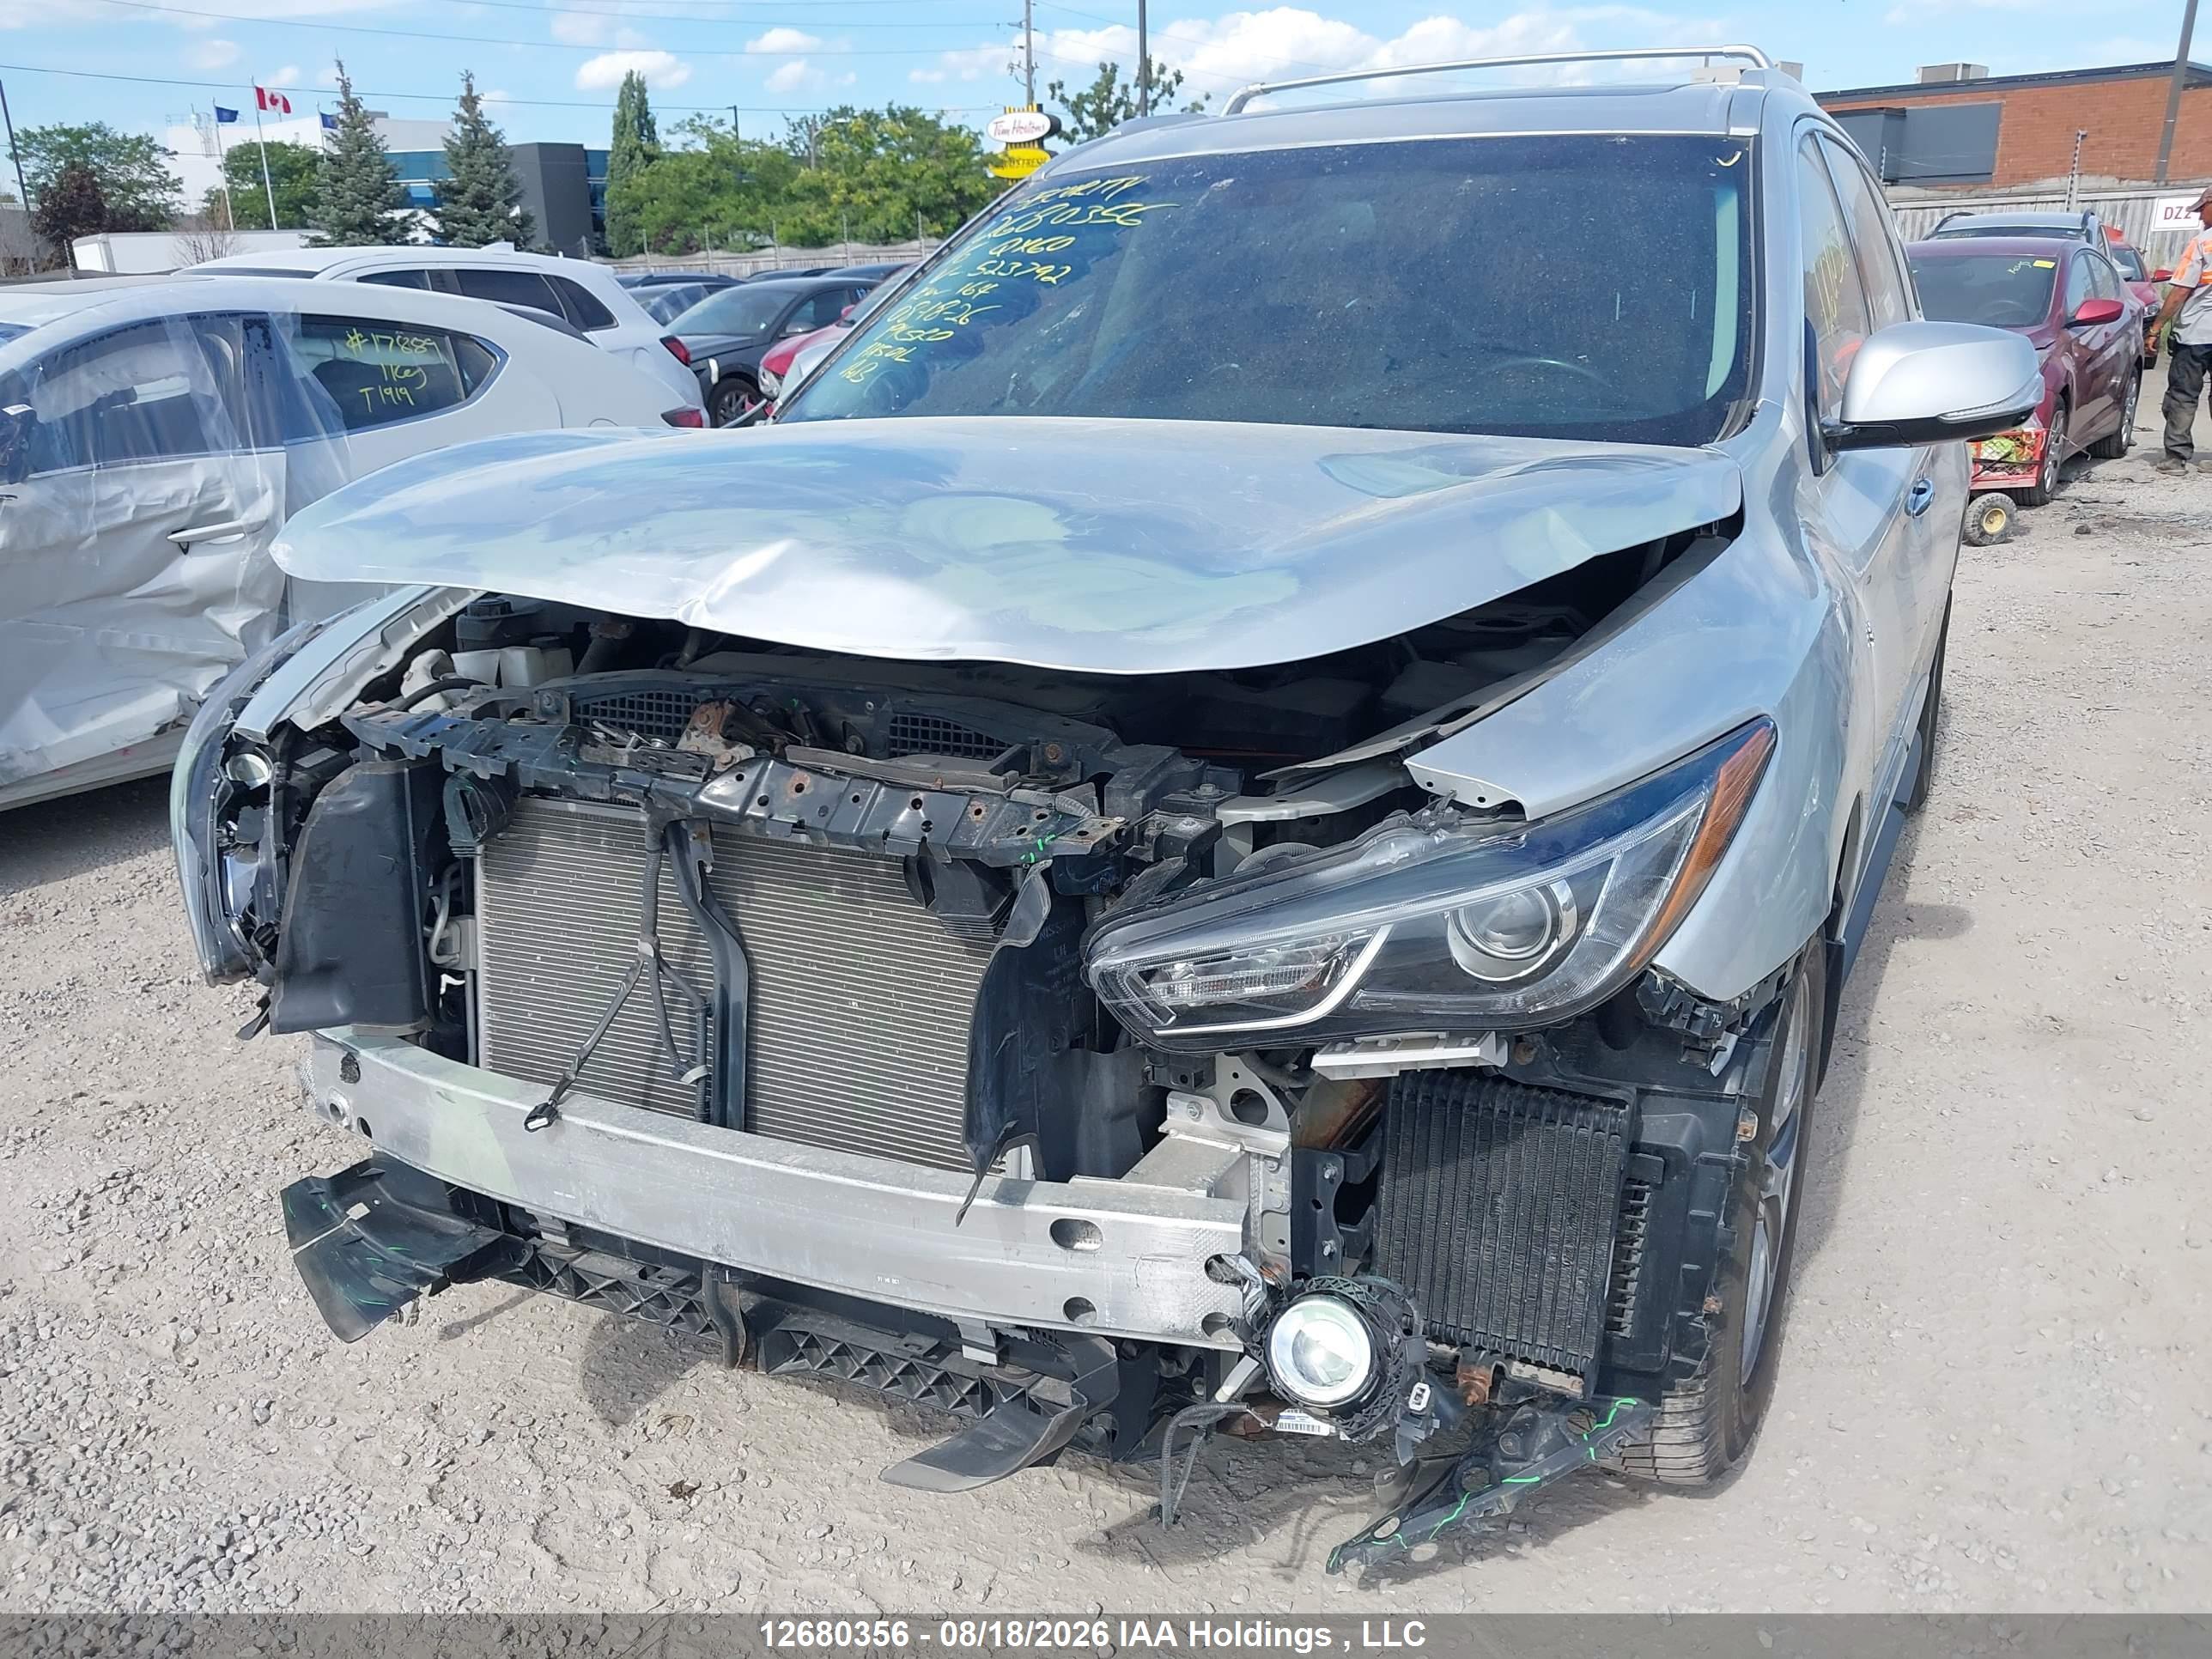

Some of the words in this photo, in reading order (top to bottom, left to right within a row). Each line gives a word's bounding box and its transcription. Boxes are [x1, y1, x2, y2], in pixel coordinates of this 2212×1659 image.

[989, 236, 1076, 258] QX60
[967, 259, 1073, 285] 523792
[954, 280, 1000, 300] 164
